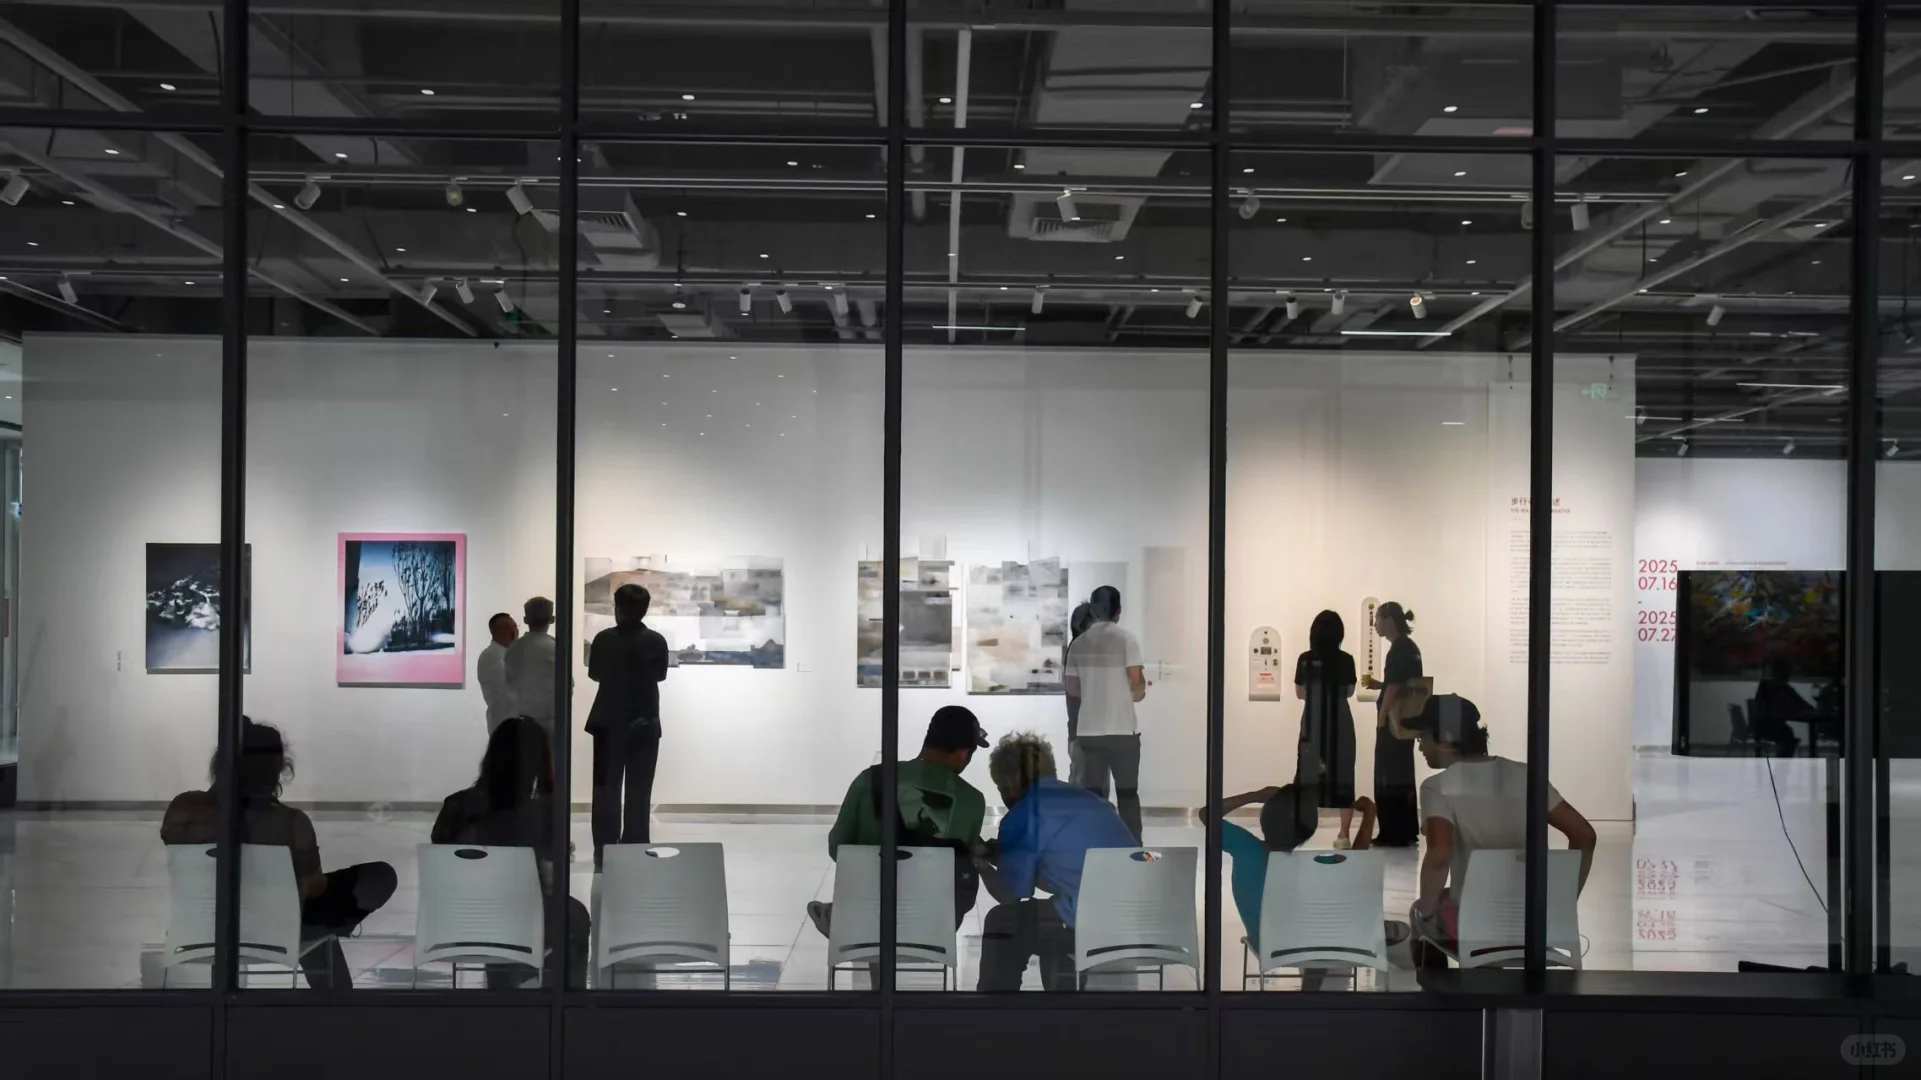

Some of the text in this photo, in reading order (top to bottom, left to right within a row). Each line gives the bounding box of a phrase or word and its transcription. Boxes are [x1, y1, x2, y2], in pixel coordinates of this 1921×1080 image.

[1638, 559, 1678, 573] 2025
[1638, 577, 1677, 591] 07.16
[1638, 611, 1676, 624] 2025
[1638, 628, 1676, 642] 07.27
